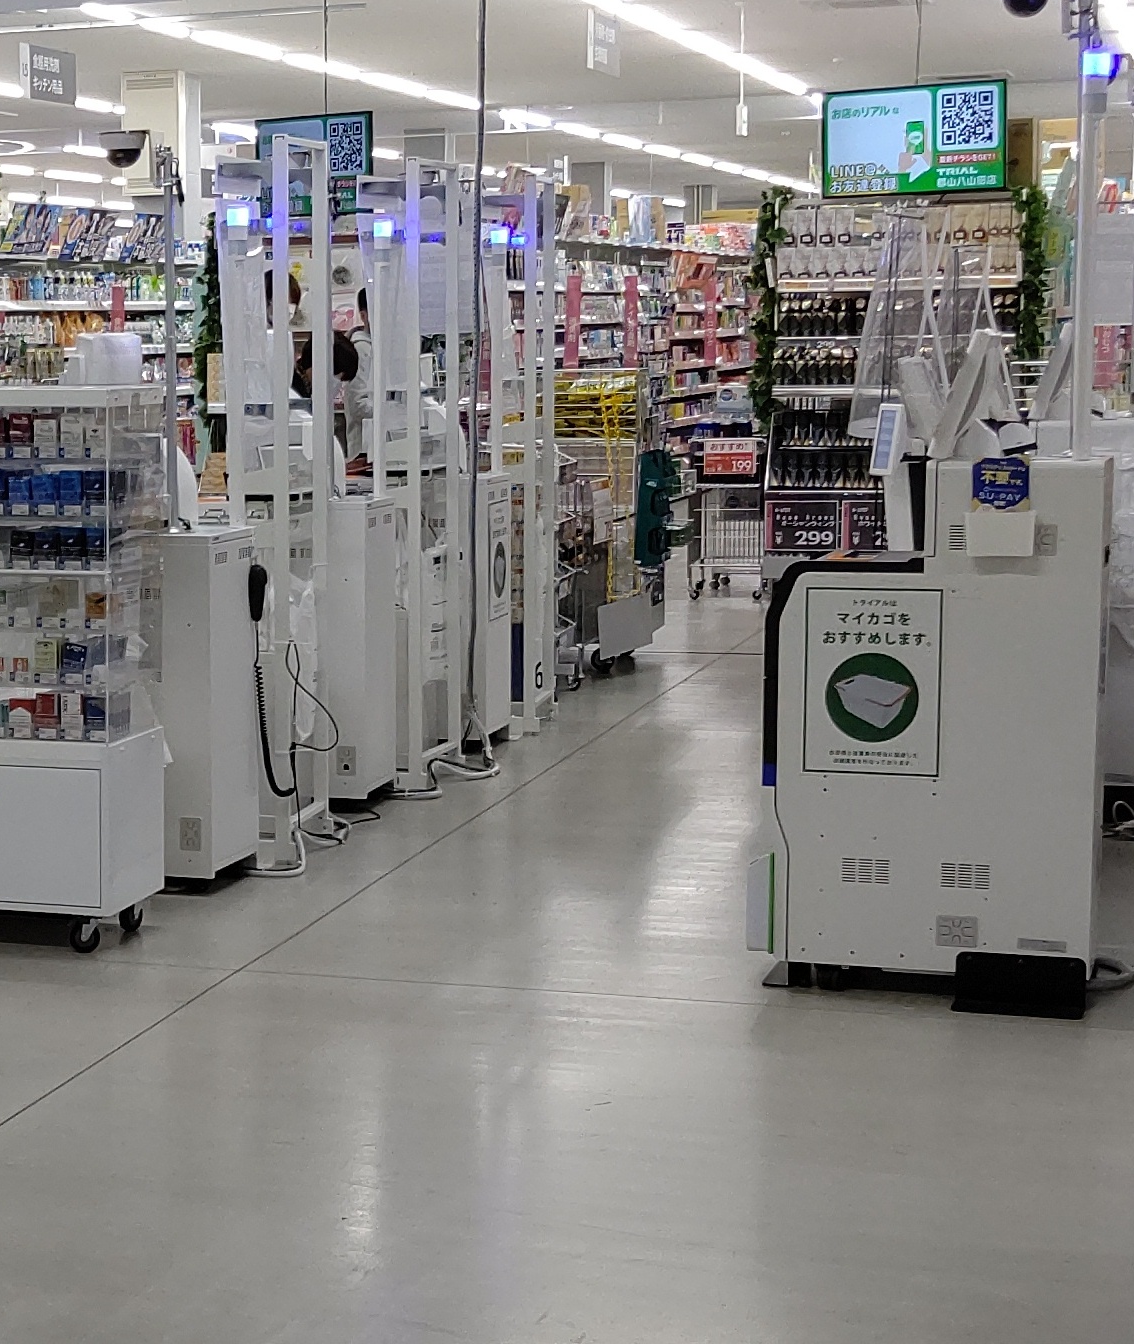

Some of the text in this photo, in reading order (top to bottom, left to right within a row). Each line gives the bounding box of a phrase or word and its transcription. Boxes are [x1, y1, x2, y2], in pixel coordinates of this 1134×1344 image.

[936, 167, 979, 176] TRIAL
[731, 460, 752, 472] 199
[793, 530, 834, 546] 299
[852, 599, 897, 607] トライアルは
[837, 612, 911, 626] マイカゴを
[822, 631, 932, 647] おすすめします。
[534, 661, 543, 689] 6
